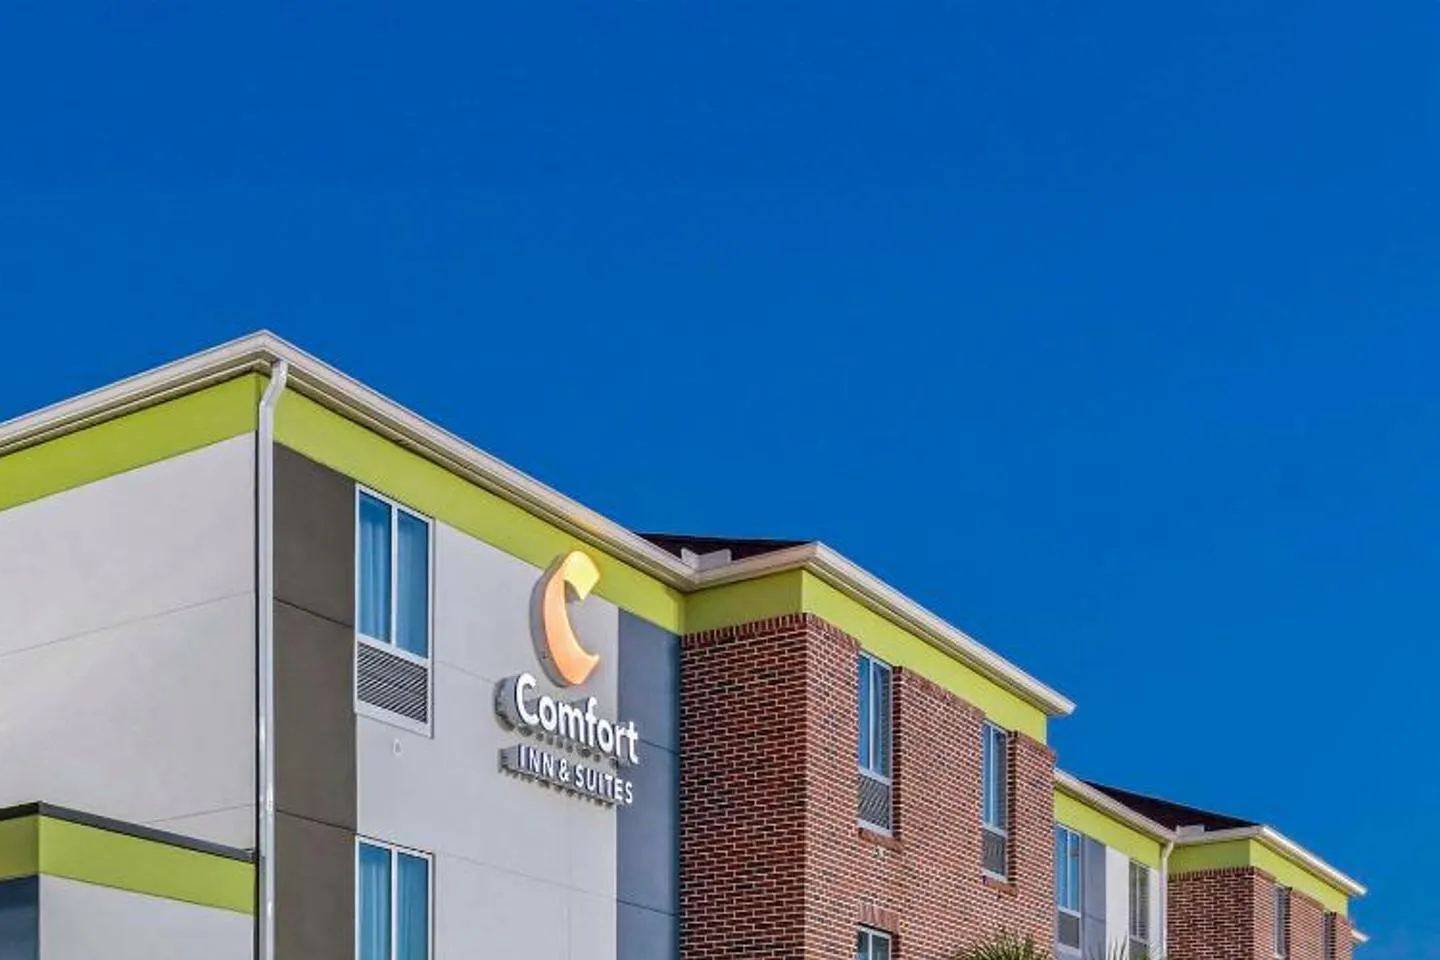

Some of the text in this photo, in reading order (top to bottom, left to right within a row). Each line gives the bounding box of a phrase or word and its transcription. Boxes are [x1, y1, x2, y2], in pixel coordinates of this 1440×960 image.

[515, 672, 639, 764] Comfort
[518, 744, 633, 803] INN & SUITES
